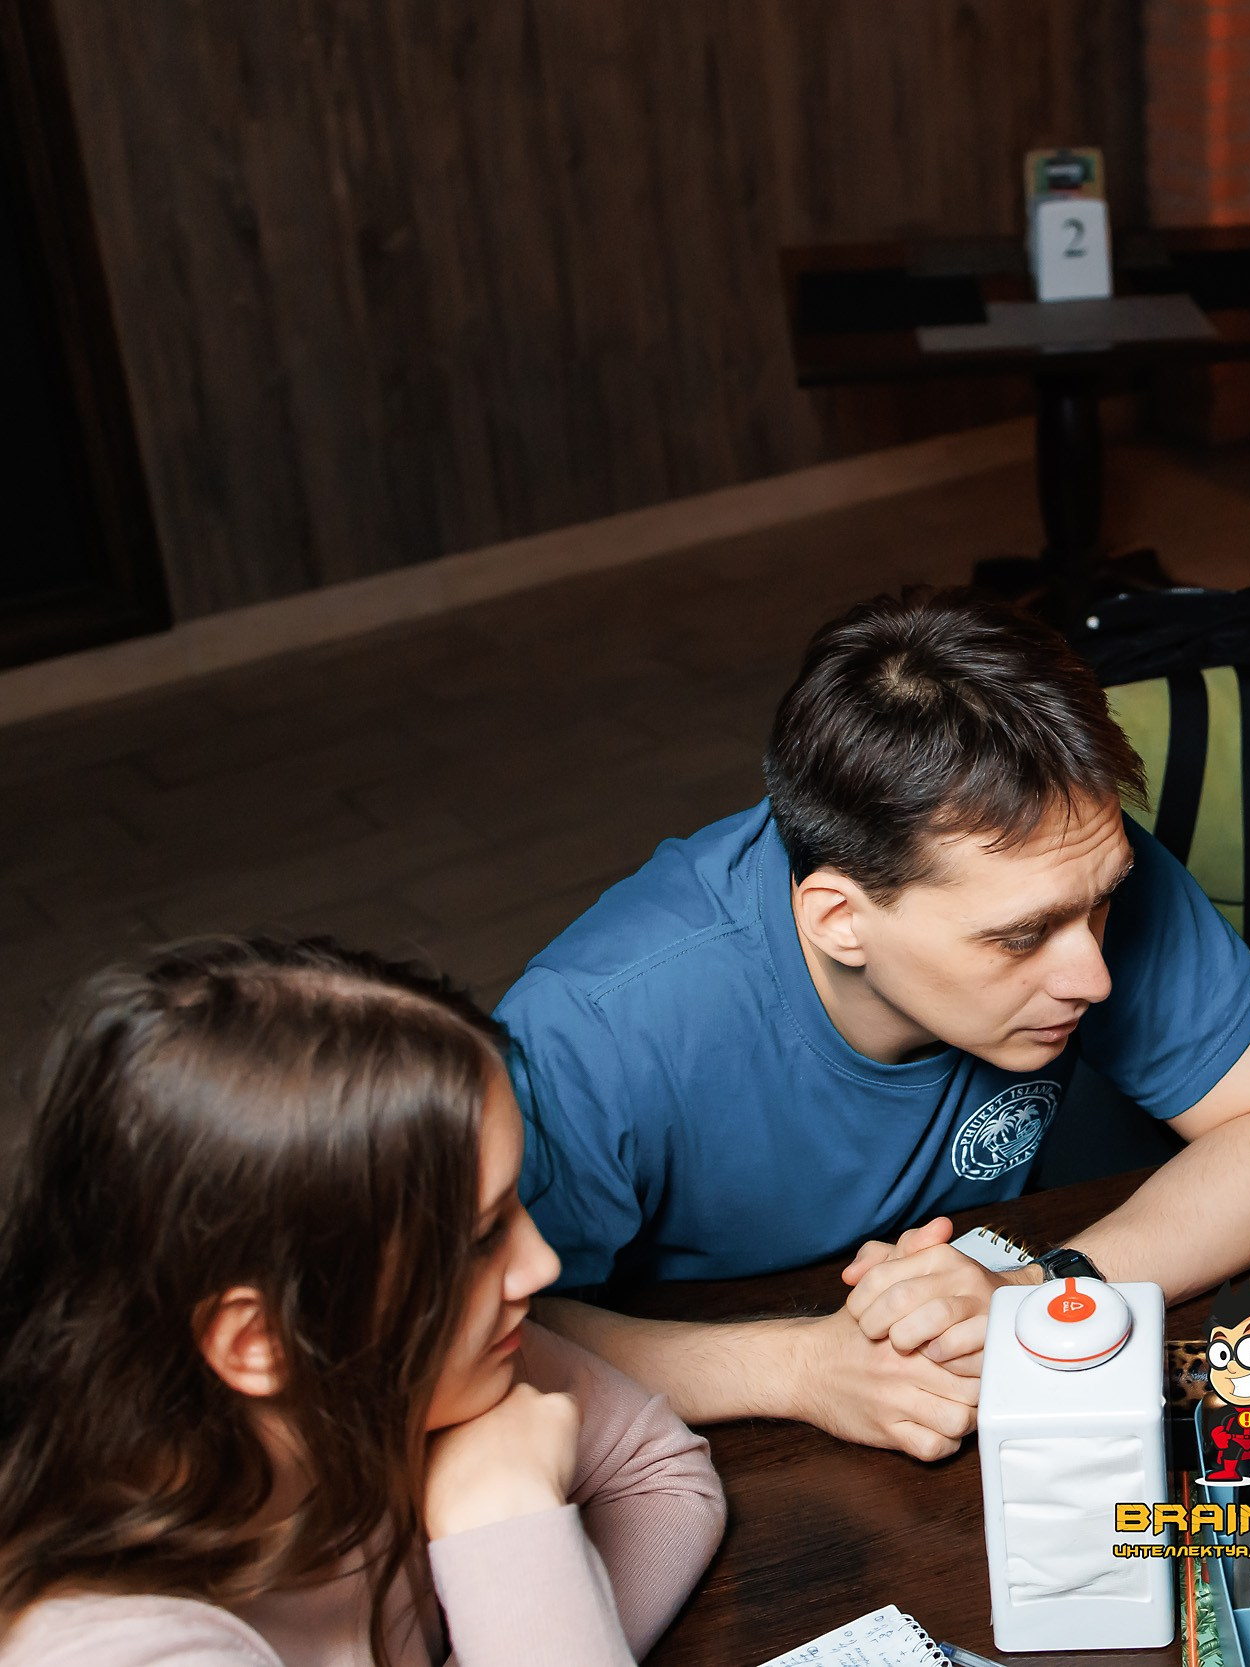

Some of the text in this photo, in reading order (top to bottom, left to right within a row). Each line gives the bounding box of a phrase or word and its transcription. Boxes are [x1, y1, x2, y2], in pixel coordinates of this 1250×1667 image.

[1062, 218, 1087, 258] 2
[960, 1084, 1054, 1145] PHUKET ISLAND
